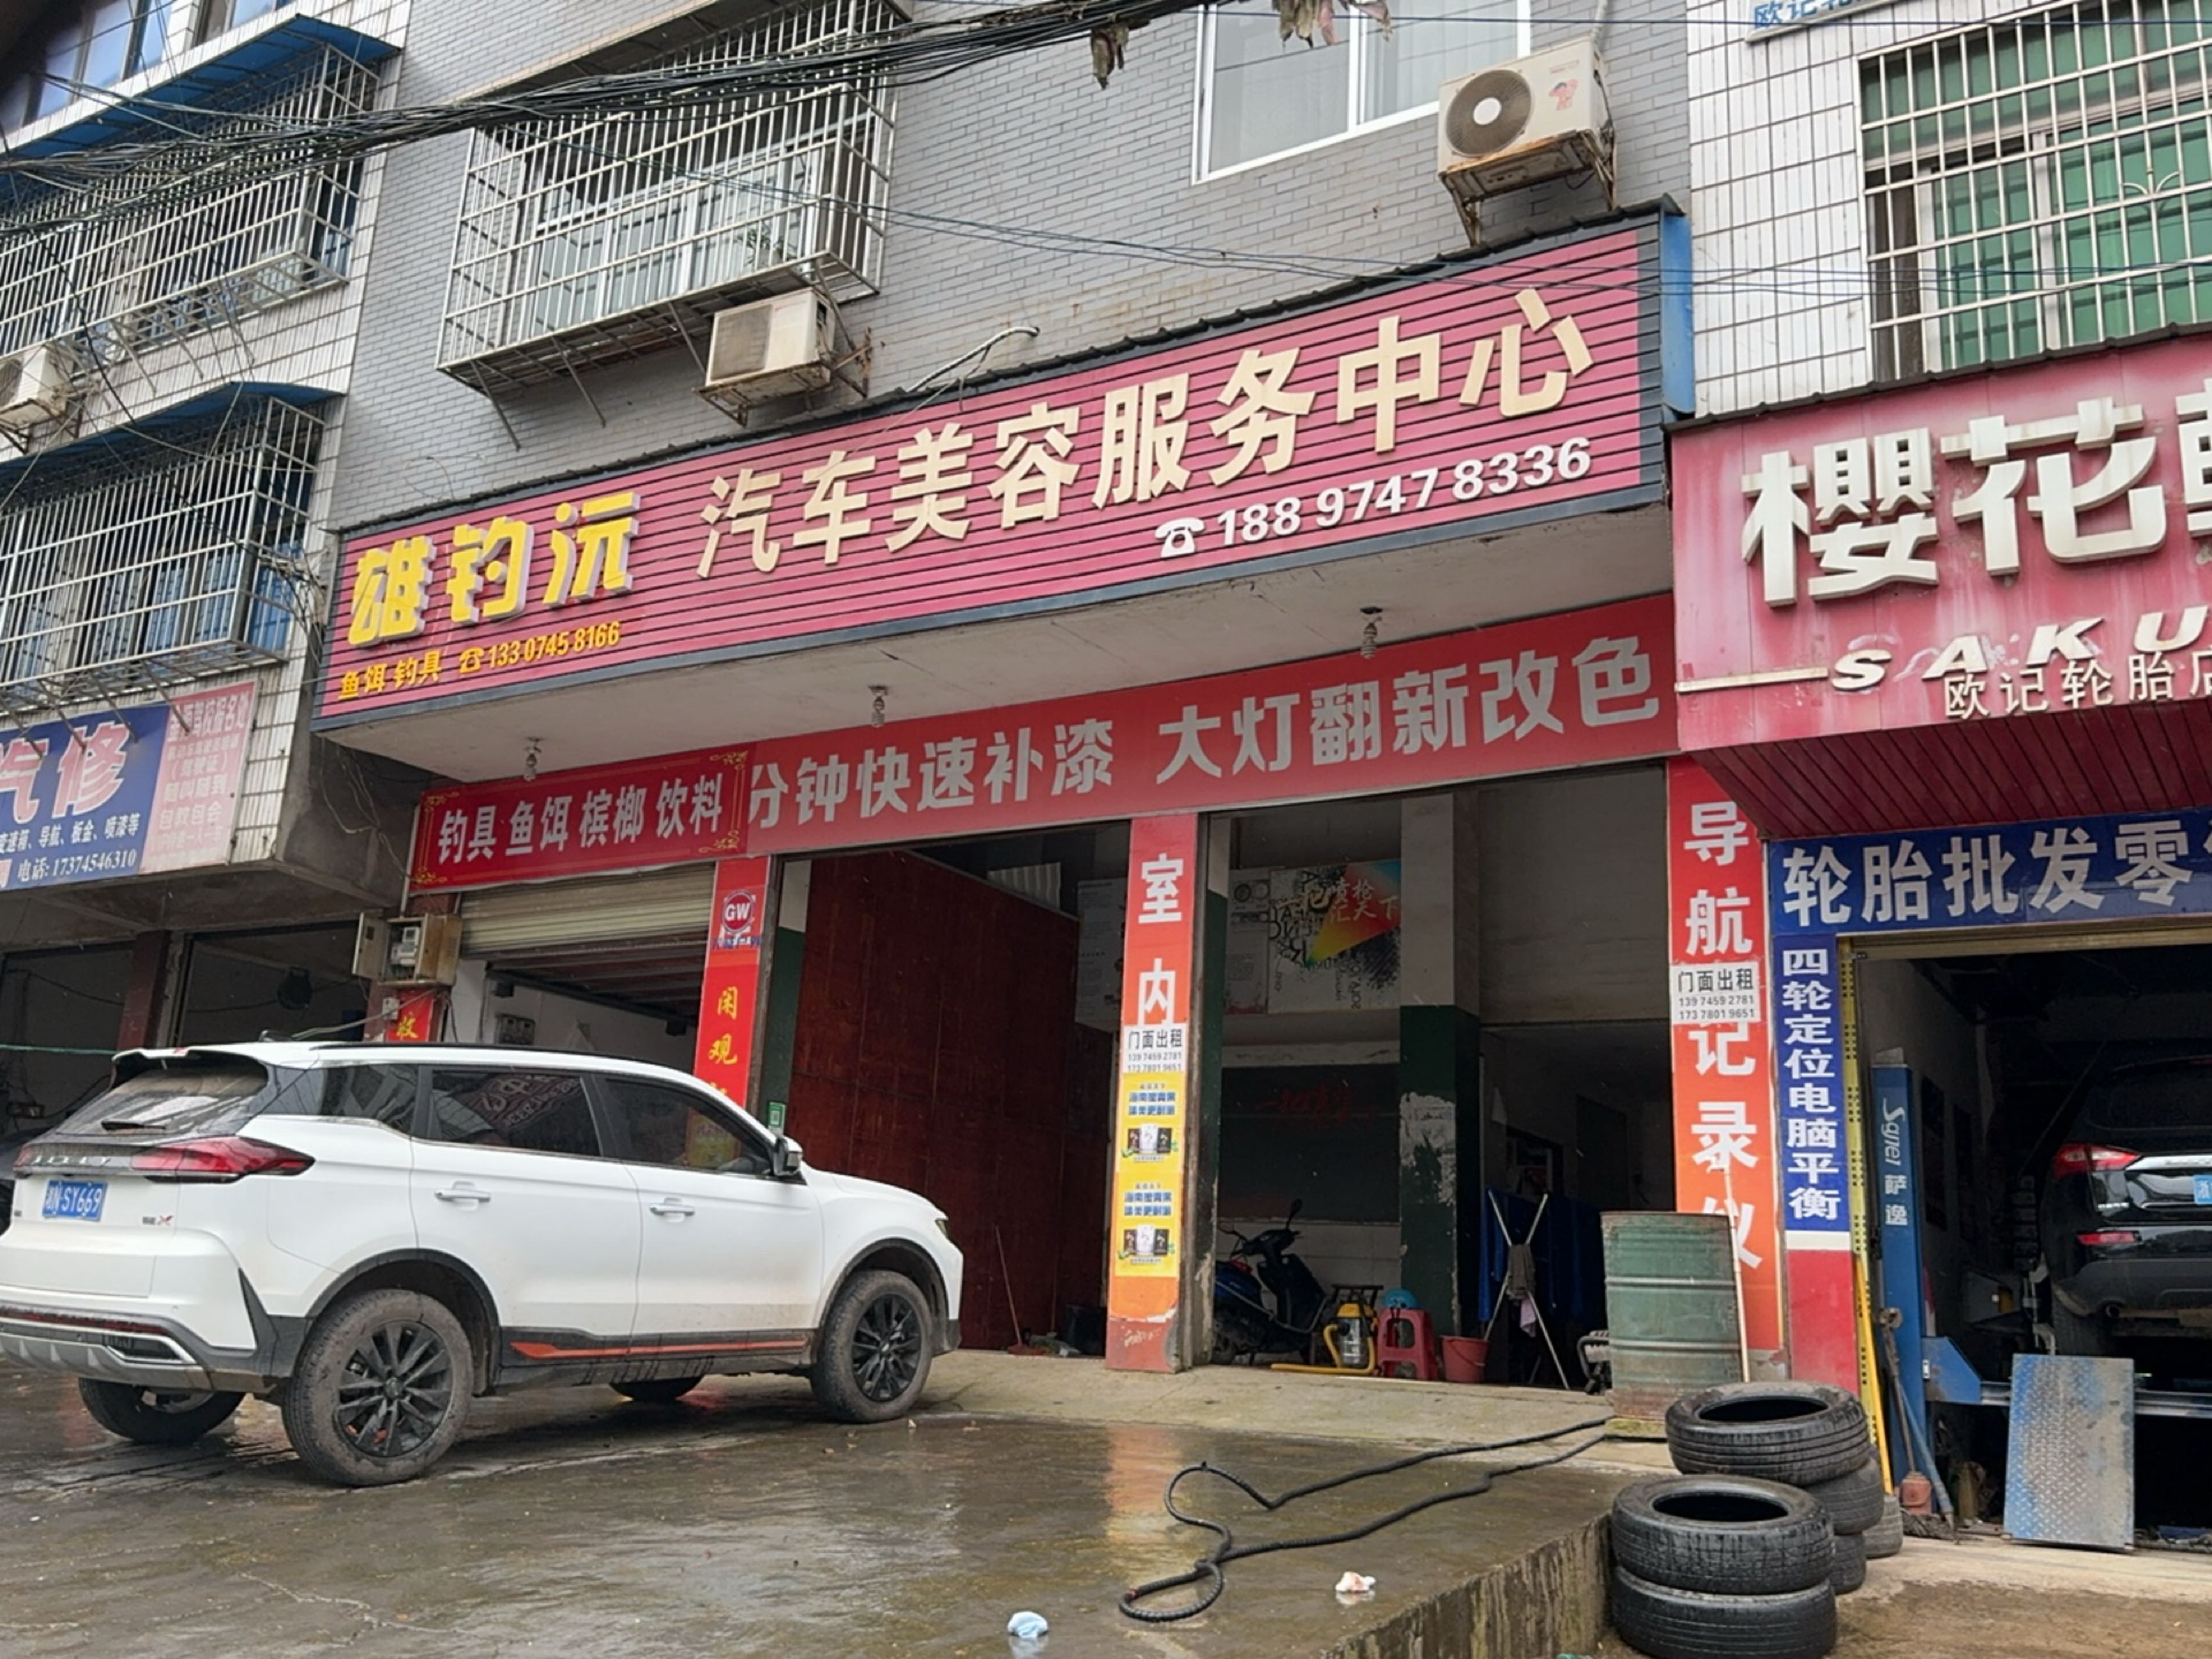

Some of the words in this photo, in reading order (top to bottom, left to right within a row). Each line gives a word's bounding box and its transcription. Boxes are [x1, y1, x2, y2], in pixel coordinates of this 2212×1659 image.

[697, 287, 1594, 577] 汽车美容服务中心
[1217, 496, 1300, 547] 188
[1316, 467, 1439, 527] 9747
[1452, 437, 1591, 500] 8336
[1741, 378, 2212, 608] 櫻花
[338, 662, 387, 700] 鱼饵
[394, 650, 442, 689] 钓具
[488, 641, 520, 669] 133
[524, 630, 570, 663] 0745
[573, 621, 620, 653] 8166
[749, 719, 1112, 829] 分钟快速补漆
[1155, 636, 1660, 785] 大灯翻新改色
[438, 805, 497, 864] 钓具
[505, 796, 572, 856] 鱼饵
[579, 785, 646, 848] 槟榔
[655, 773, 723, 839] 饮料
[726, 902, 751, 921] GW
[1783, 820, 2212, 926] 轮胎批发零
[1137, 853, 1183, 1025] 室内
[1678, 967, 1754, 993] 门面出租
[1128, 1029, 1183, 1050] 门面出租
[1679, 996, 1698, 1007] 139
[1700, 996, 1726, 1006] 7459
[1728, 995, 1754, 1006] 2781
[1679, 1009, 1698, 1020] 173
[1701, 1009, 1726, 1020] 7801
[1729, 1008, 1755, 1019] 9651
[1783, 949, 1841, 1220] 四轮定位电脑平衡
